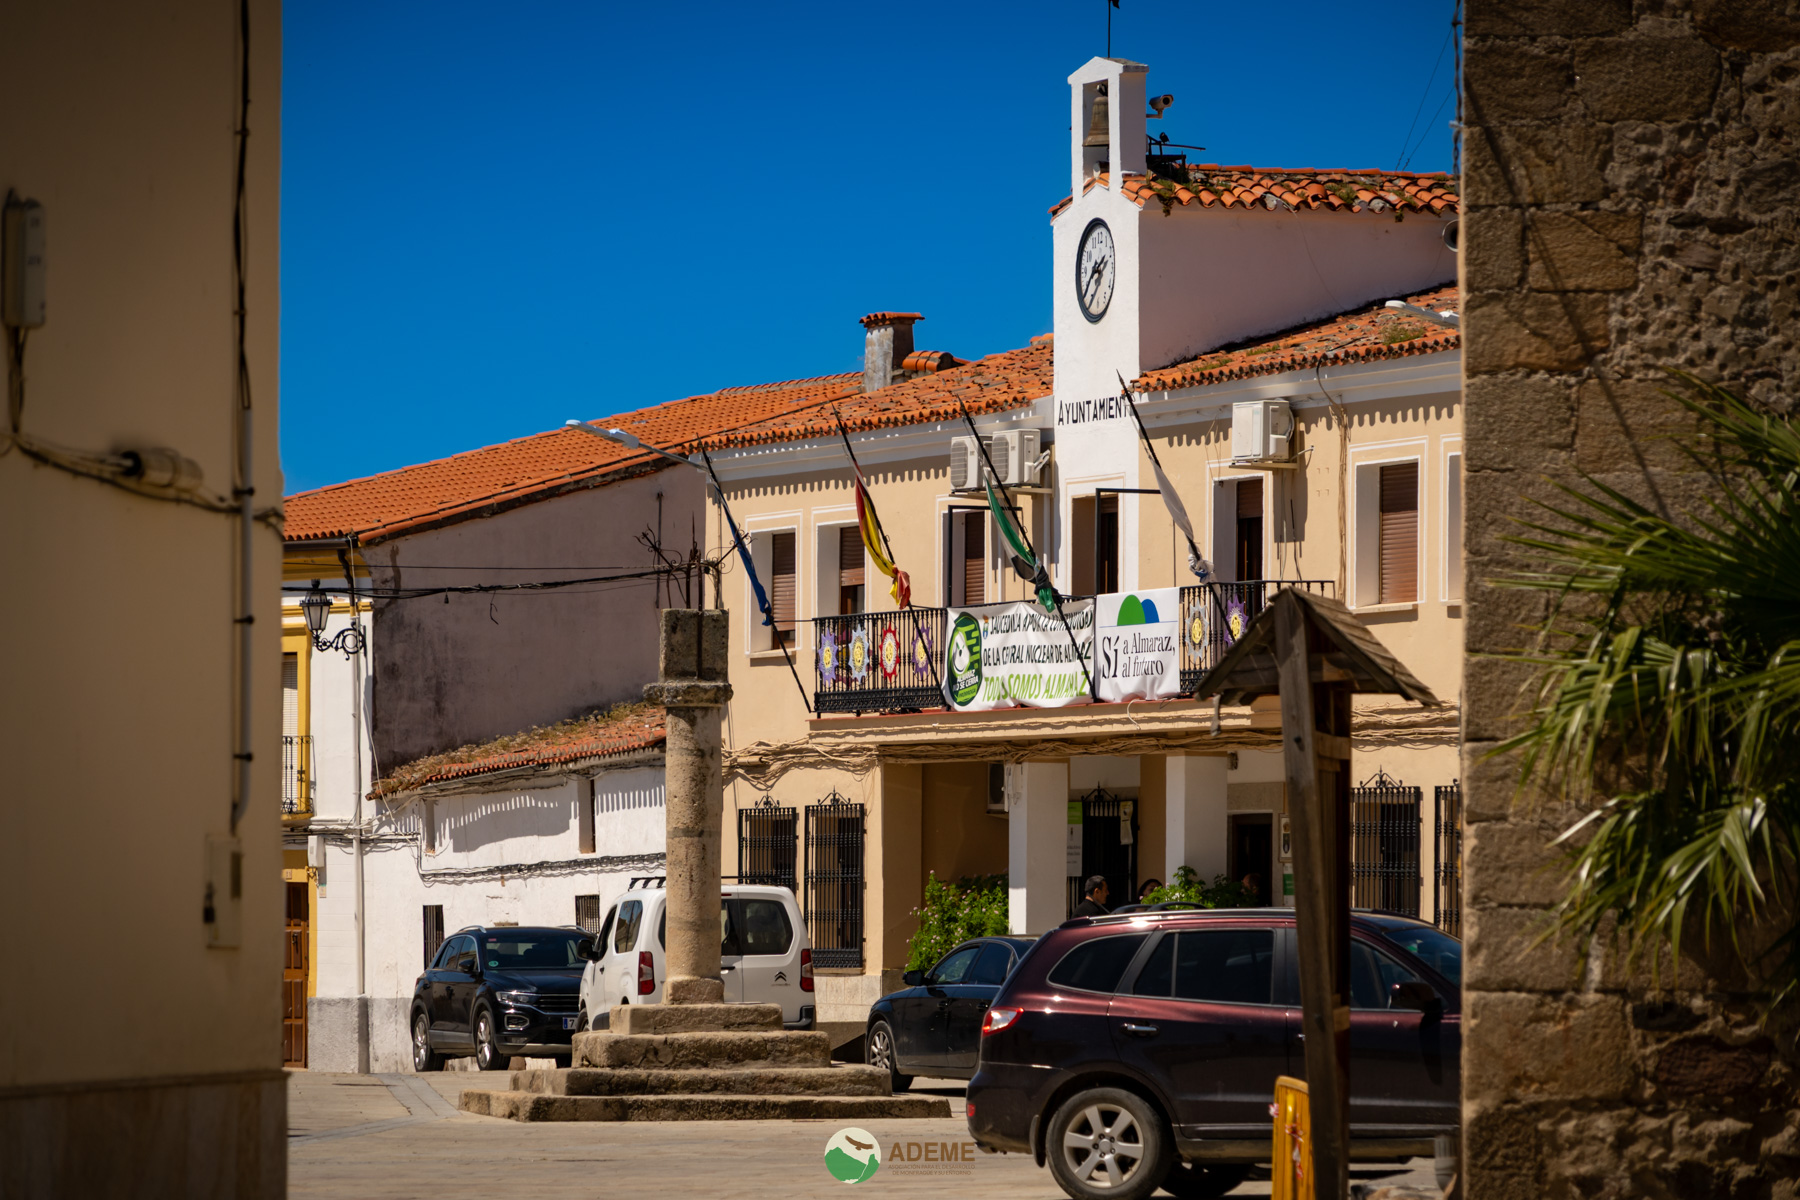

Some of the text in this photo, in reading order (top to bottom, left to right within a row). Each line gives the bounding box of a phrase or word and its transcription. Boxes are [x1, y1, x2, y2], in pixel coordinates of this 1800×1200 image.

[1058, 396, 1128, 426] AYUNTAMIENT
[983, 647, 992, 667] DE
[992, 647, 1001, 666] LA
[1102, 632, 1176, 679] Sí a Almaraz,
[1122, 655, 1164, 678] al futuro
[1007, 673, 1043, 700] SOMOS
